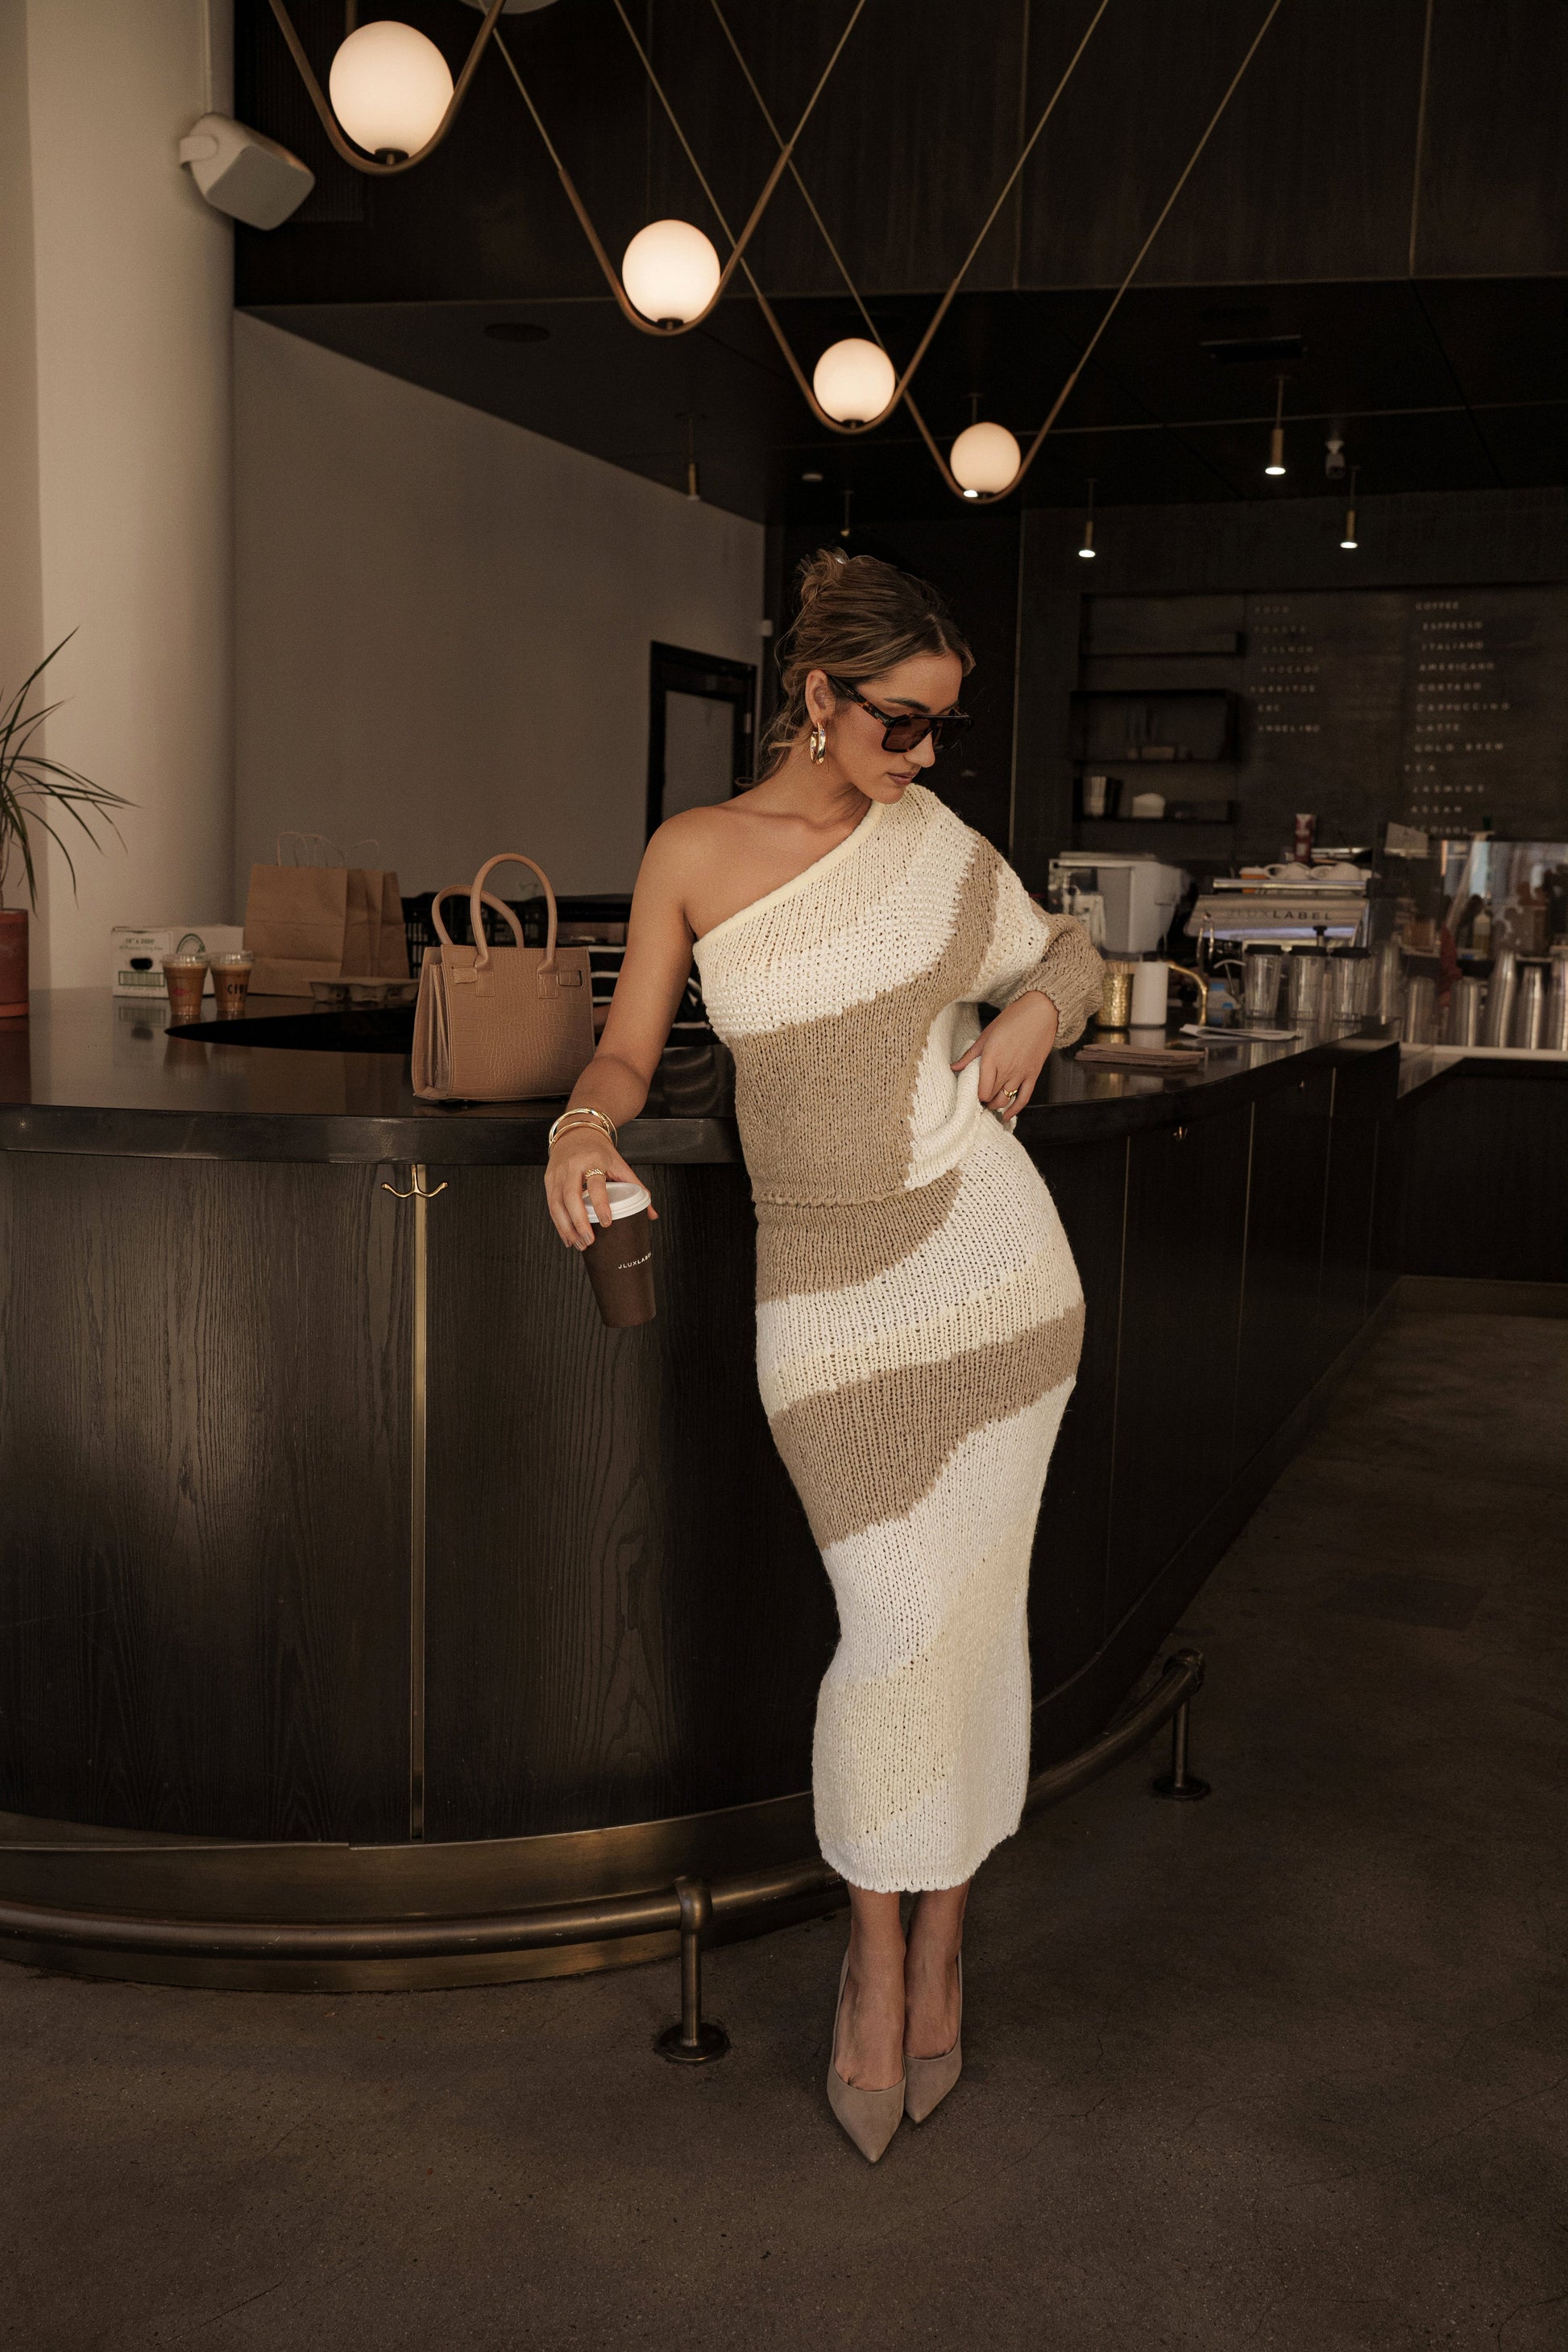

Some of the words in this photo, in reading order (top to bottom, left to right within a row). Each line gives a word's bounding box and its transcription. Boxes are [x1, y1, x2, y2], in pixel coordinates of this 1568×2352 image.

[1416, 601, 1458, 611] COFFEE
[1422, 620, 1483, 631] ESPRESSO
[1422, 641, 1484, 651] ITALIANO
[1419, 662, 1495, 672] AMERICANO
[1417, 682, 1482, 693] CORTADO
[1416, 702, 1510, 713] CAPPUCCINO
[1416, 723, 1459, 732] LATTE
[1414, 743, 1454, 753] COLD
[1465, 742, 1504, 751] BREW
[1404, 764, 1436, 773] TEA
[1412, 784, 1484, 794] JASMINE
